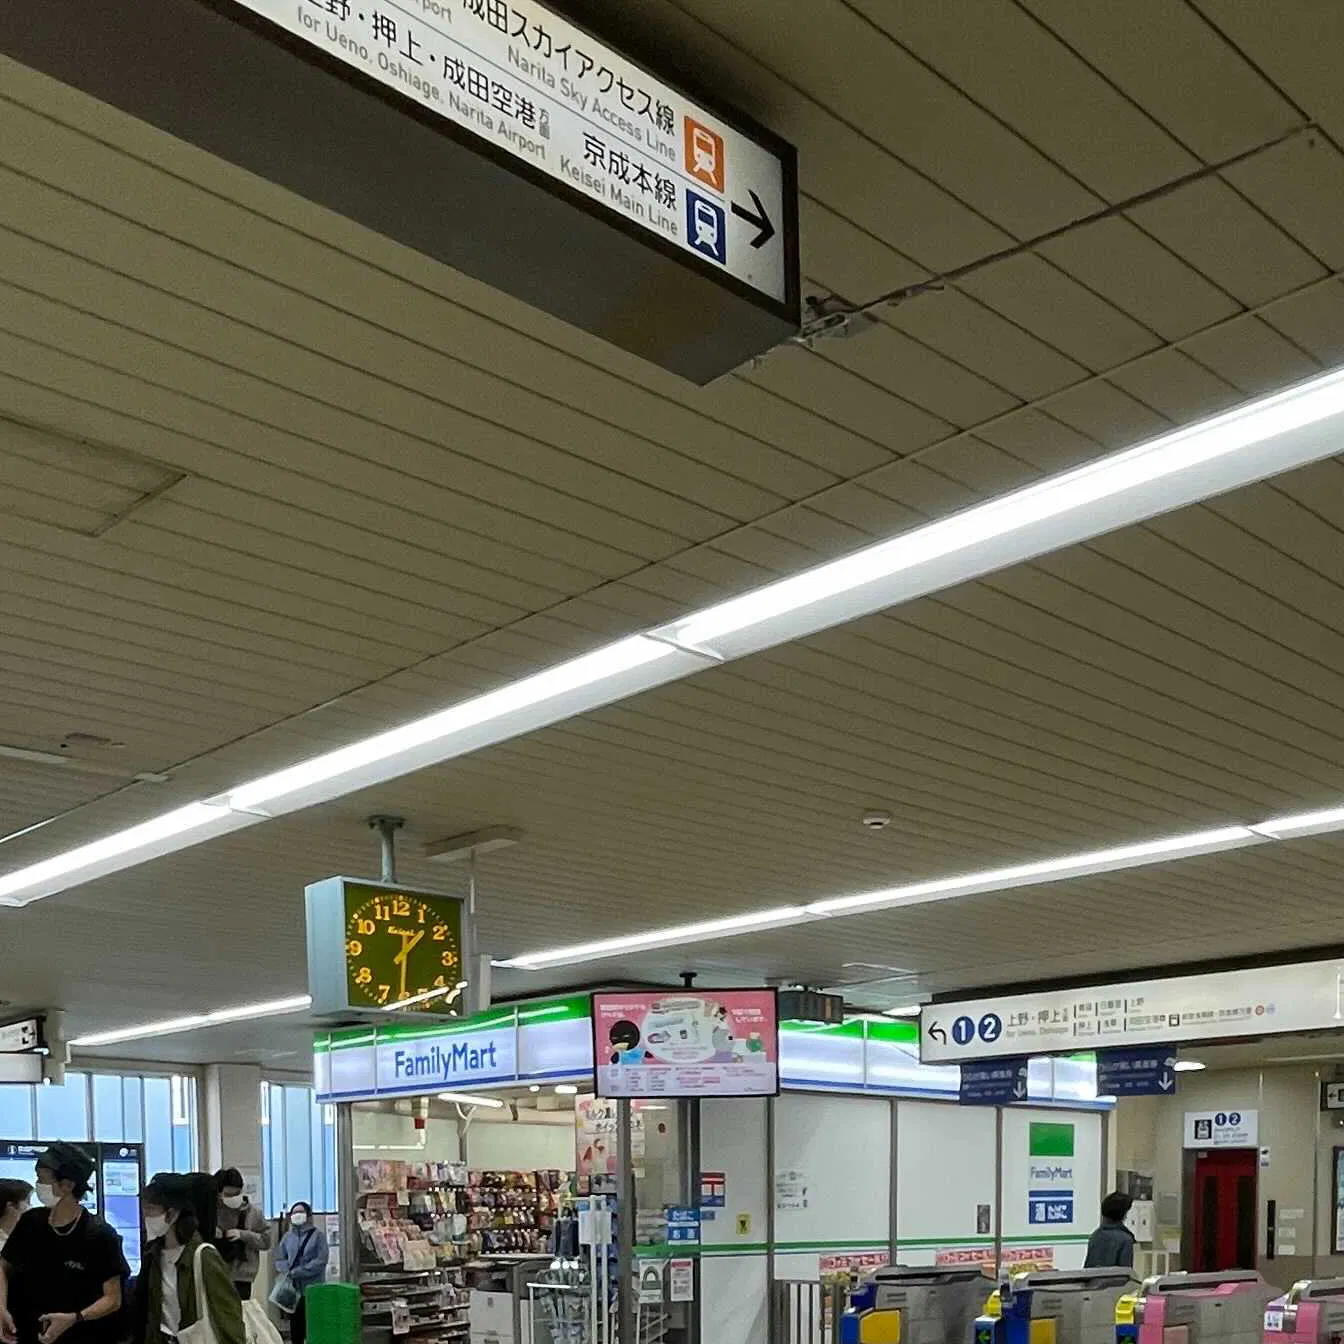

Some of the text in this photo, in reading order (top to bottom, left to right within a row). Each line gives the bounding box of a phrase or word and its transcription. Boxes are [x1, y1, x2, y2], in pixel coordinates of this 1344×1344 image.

[297, 6, 321, 32] for
[448, 91, 494, 132] Narita
[498, 120, 546, 160] Airport
[507, 45, 677, 162] Narita Sky Access Line
[582, 131, 678, 211] 京成本線
[560, 154, 678, 236] Keisei Main Line
[375, 903, 390, 921] 11
[392, 899, 410, 916] 12
[358, 920, 376, 936] 10
[433, 925, 446, 940] 2
[349, 940, 362, 957] 9
[441, 951, 454, 966] 3
[360, 967, 372, 983] 8
[433, 975, 446, 986] 4
[378, 984, 391, 1000] 7
[394, 1040, 497, 1080] FamilyMart
[1030, 1166, 1073, 1181] FamilyMart
